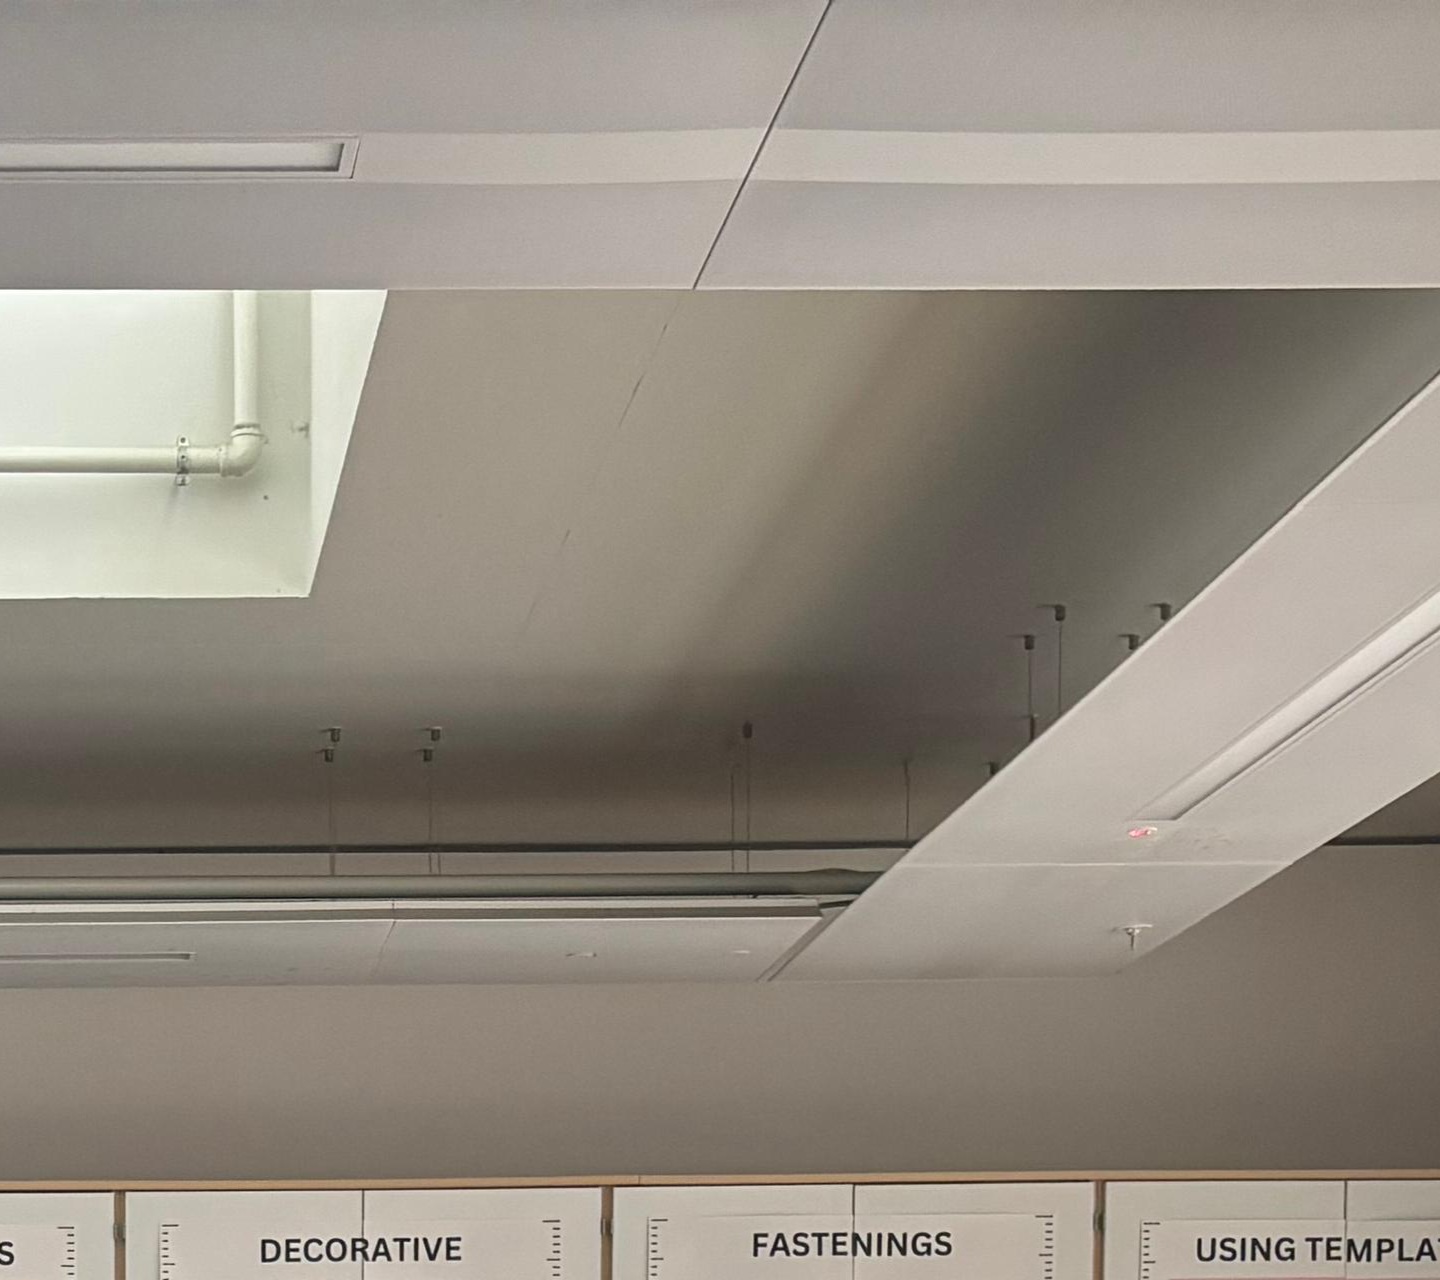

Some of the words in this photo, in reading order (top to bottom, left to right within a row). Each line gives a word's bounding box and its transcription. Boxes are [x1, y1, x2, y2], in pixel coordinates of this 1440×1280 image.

[260, 1237, 463, 1263] DECORATIVE
[752, 1231, 953, 1258] FASTENINGS
[1196, 1237, 1296, 1262] USING
[1304, 1237, 1440, 1263] TEMPLA
